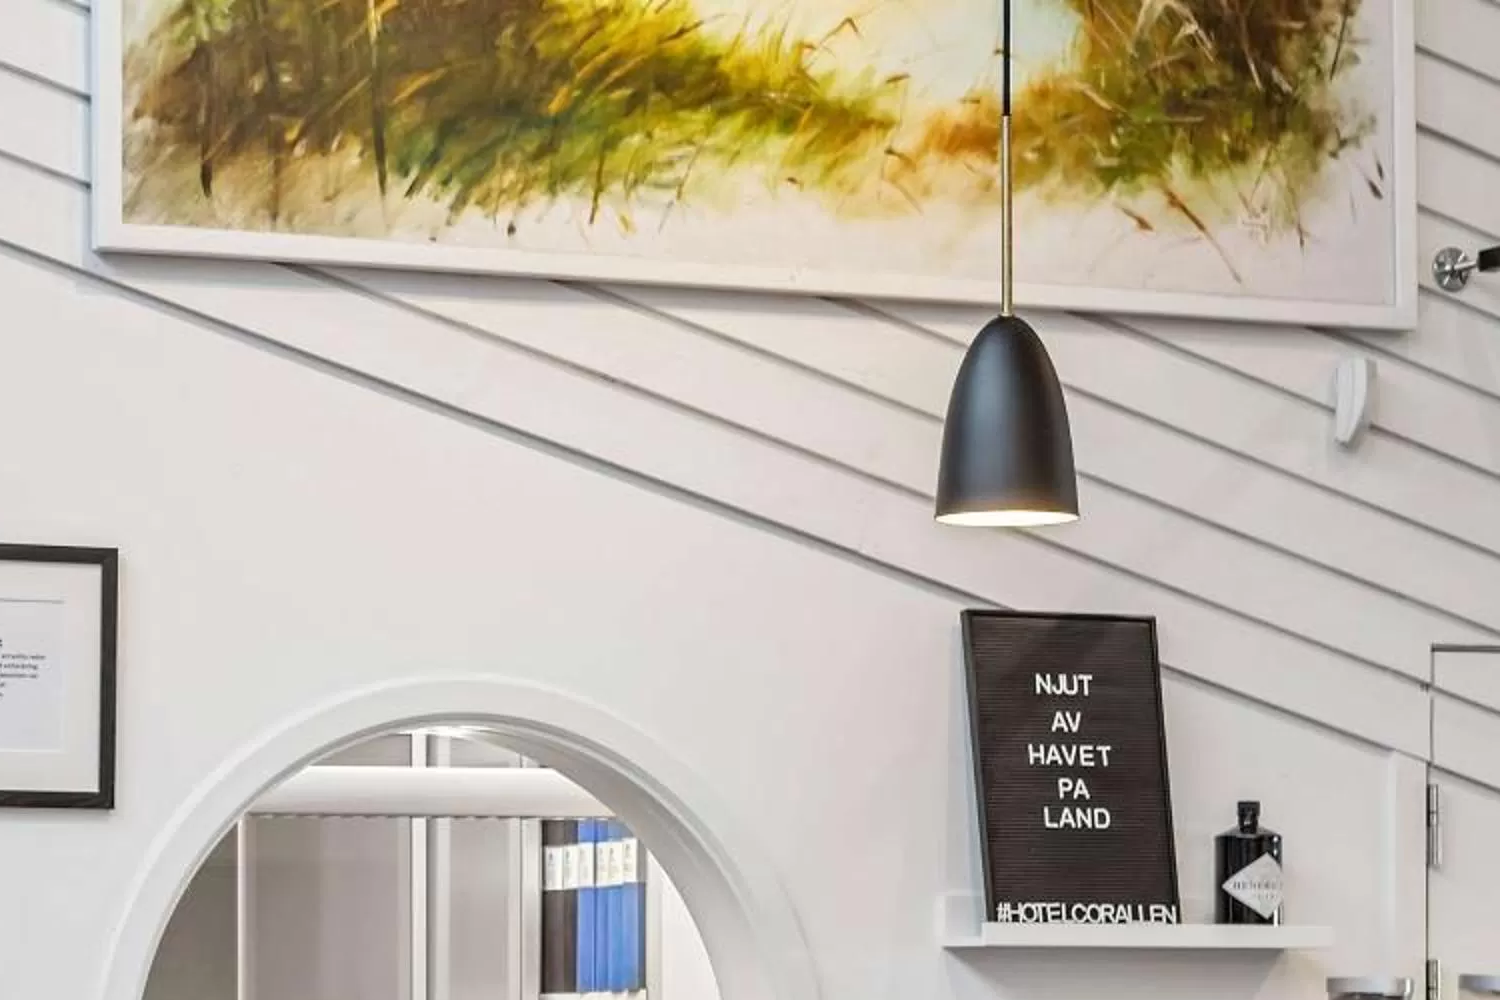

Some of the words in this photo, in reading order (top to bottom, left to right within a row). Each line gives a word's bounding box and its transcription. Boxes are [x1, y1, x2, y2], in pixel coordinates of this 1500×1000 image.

[1035, 673, 1093, 696] NJUT
[1051, 711, 1082, 733] AV
[1027, 743, 1112, 767] HAVET
[1057, 778, 1091, 800] PA
[1043, 806, 1111, 829] LAND
